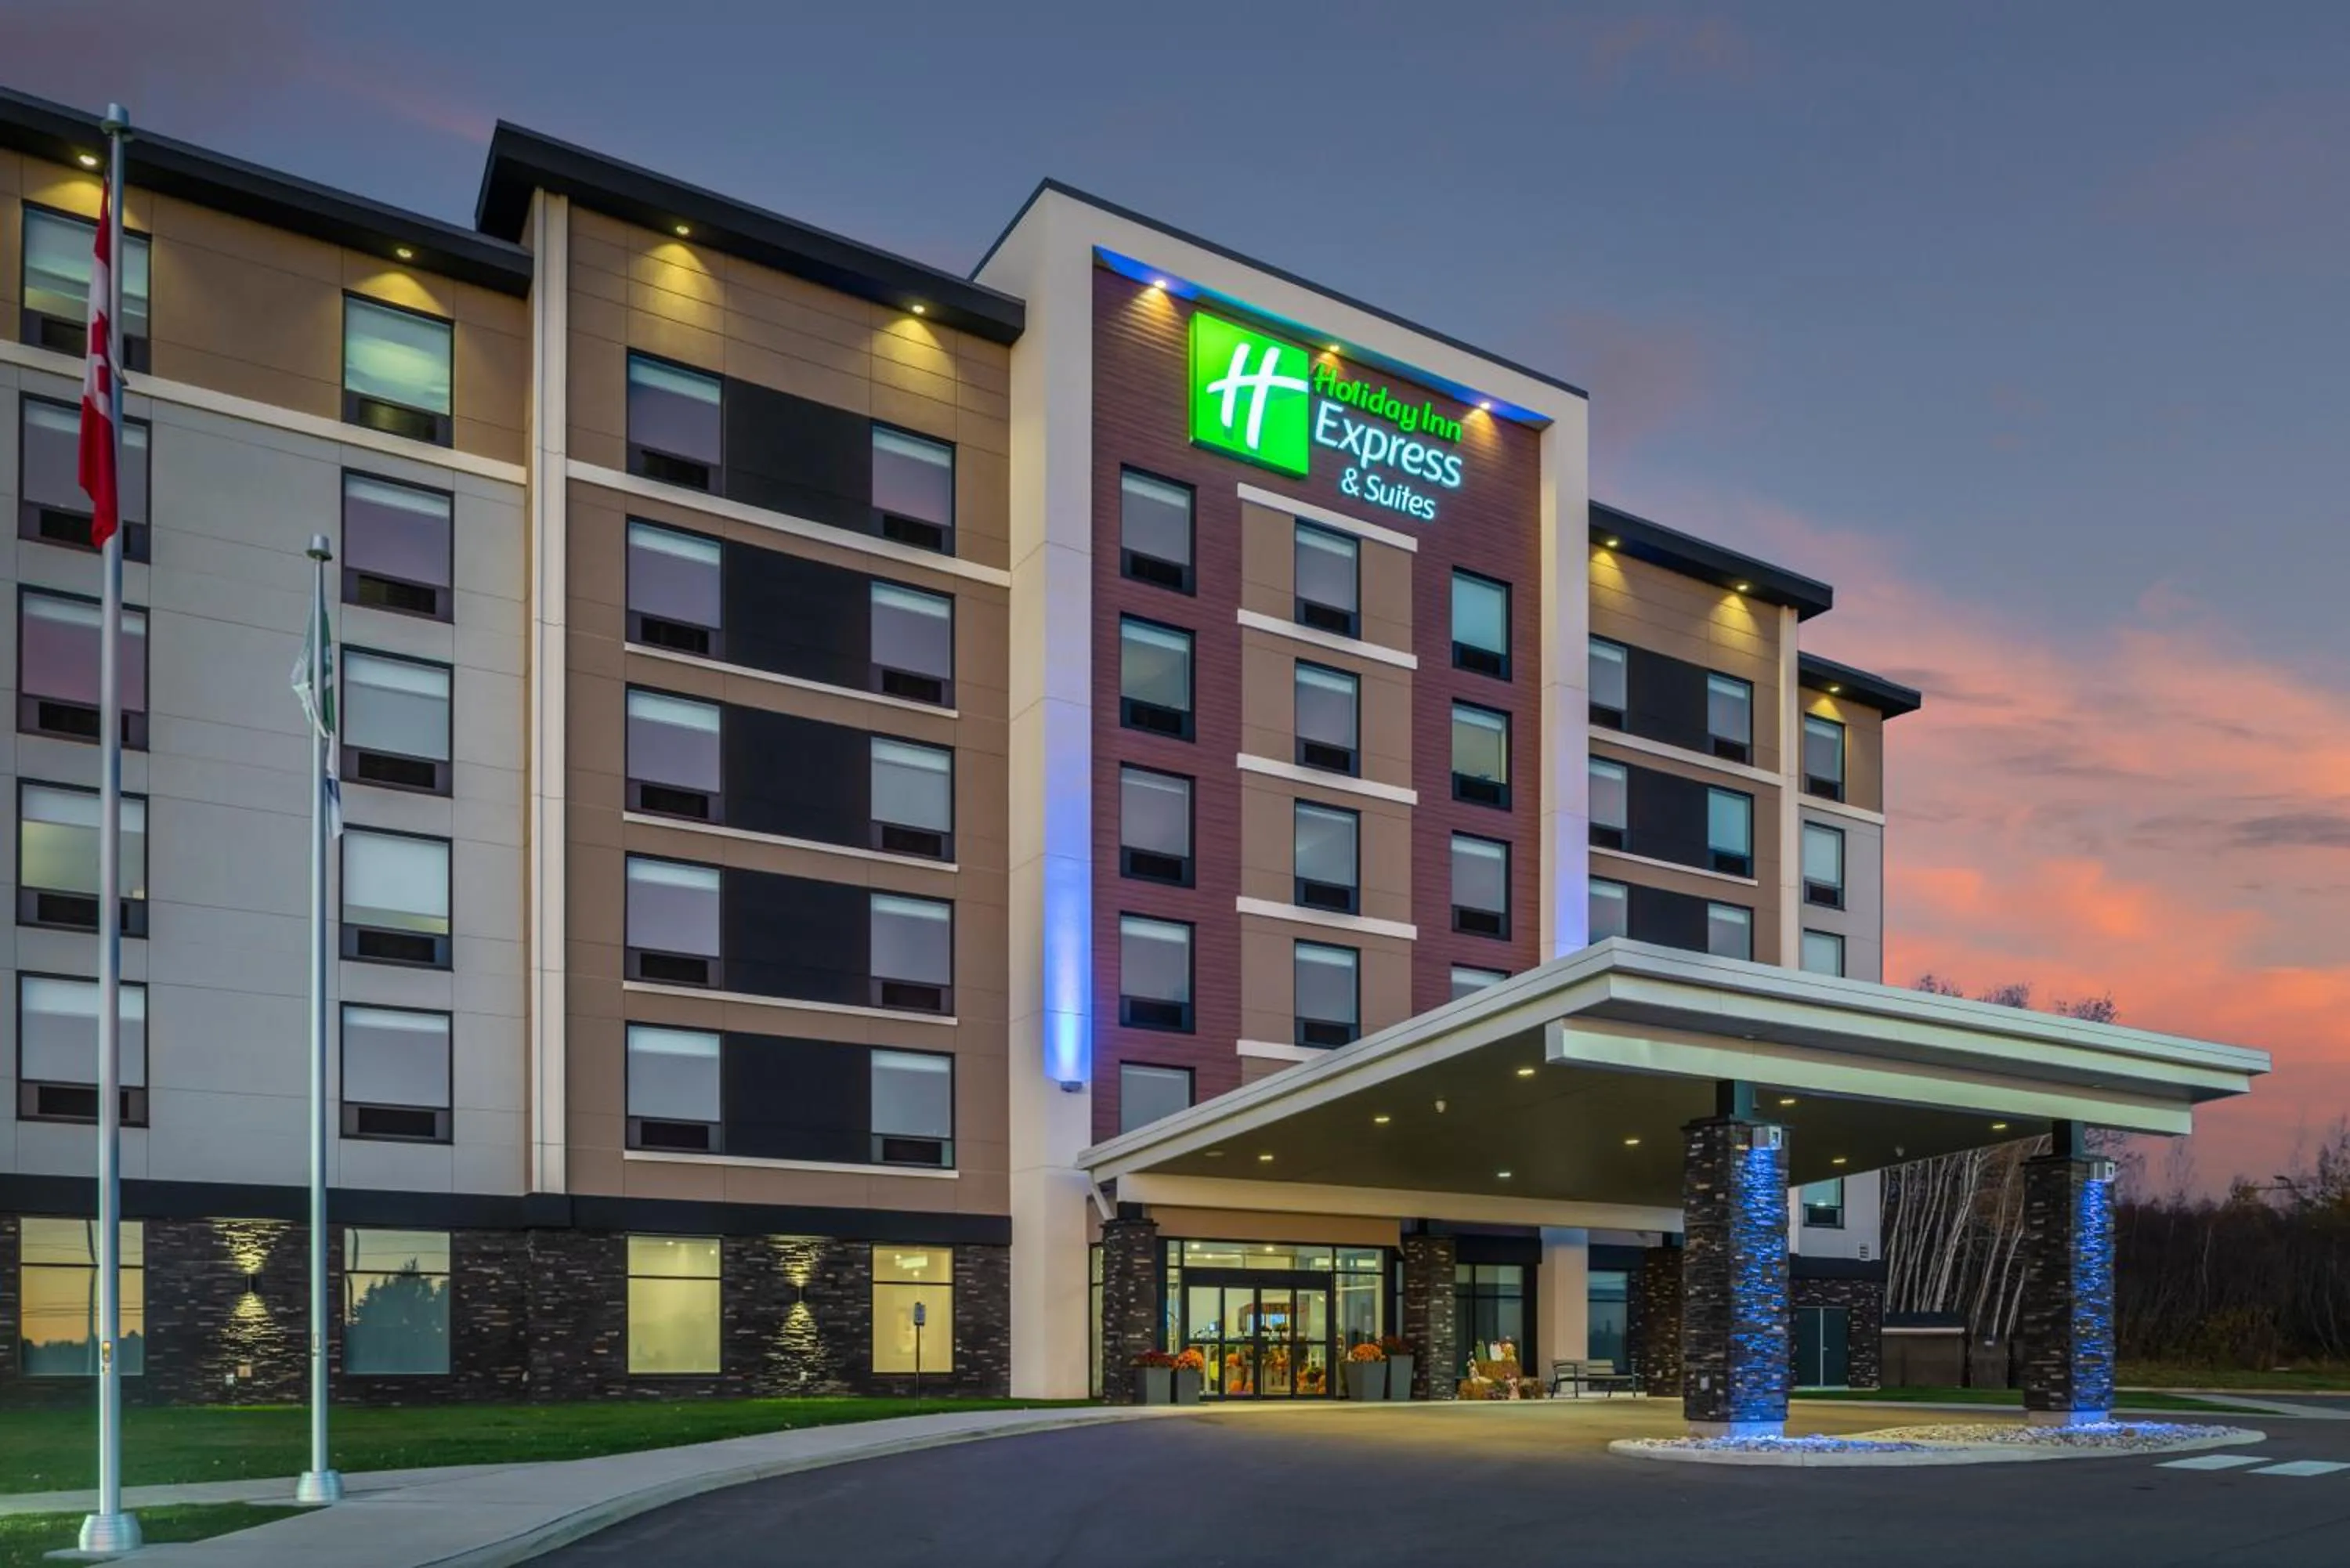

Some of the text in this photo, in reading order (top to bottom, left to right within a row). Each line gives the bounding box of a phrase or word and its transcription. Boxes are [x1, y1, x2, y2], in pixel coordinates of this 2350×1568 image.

[1206, 342, 1309, 450] H
[1314, 364, 1463, 443] Holiday Inn
[1314, 399, 1463, 489] Express
[1341, 468, 1437, 520] & Suites
